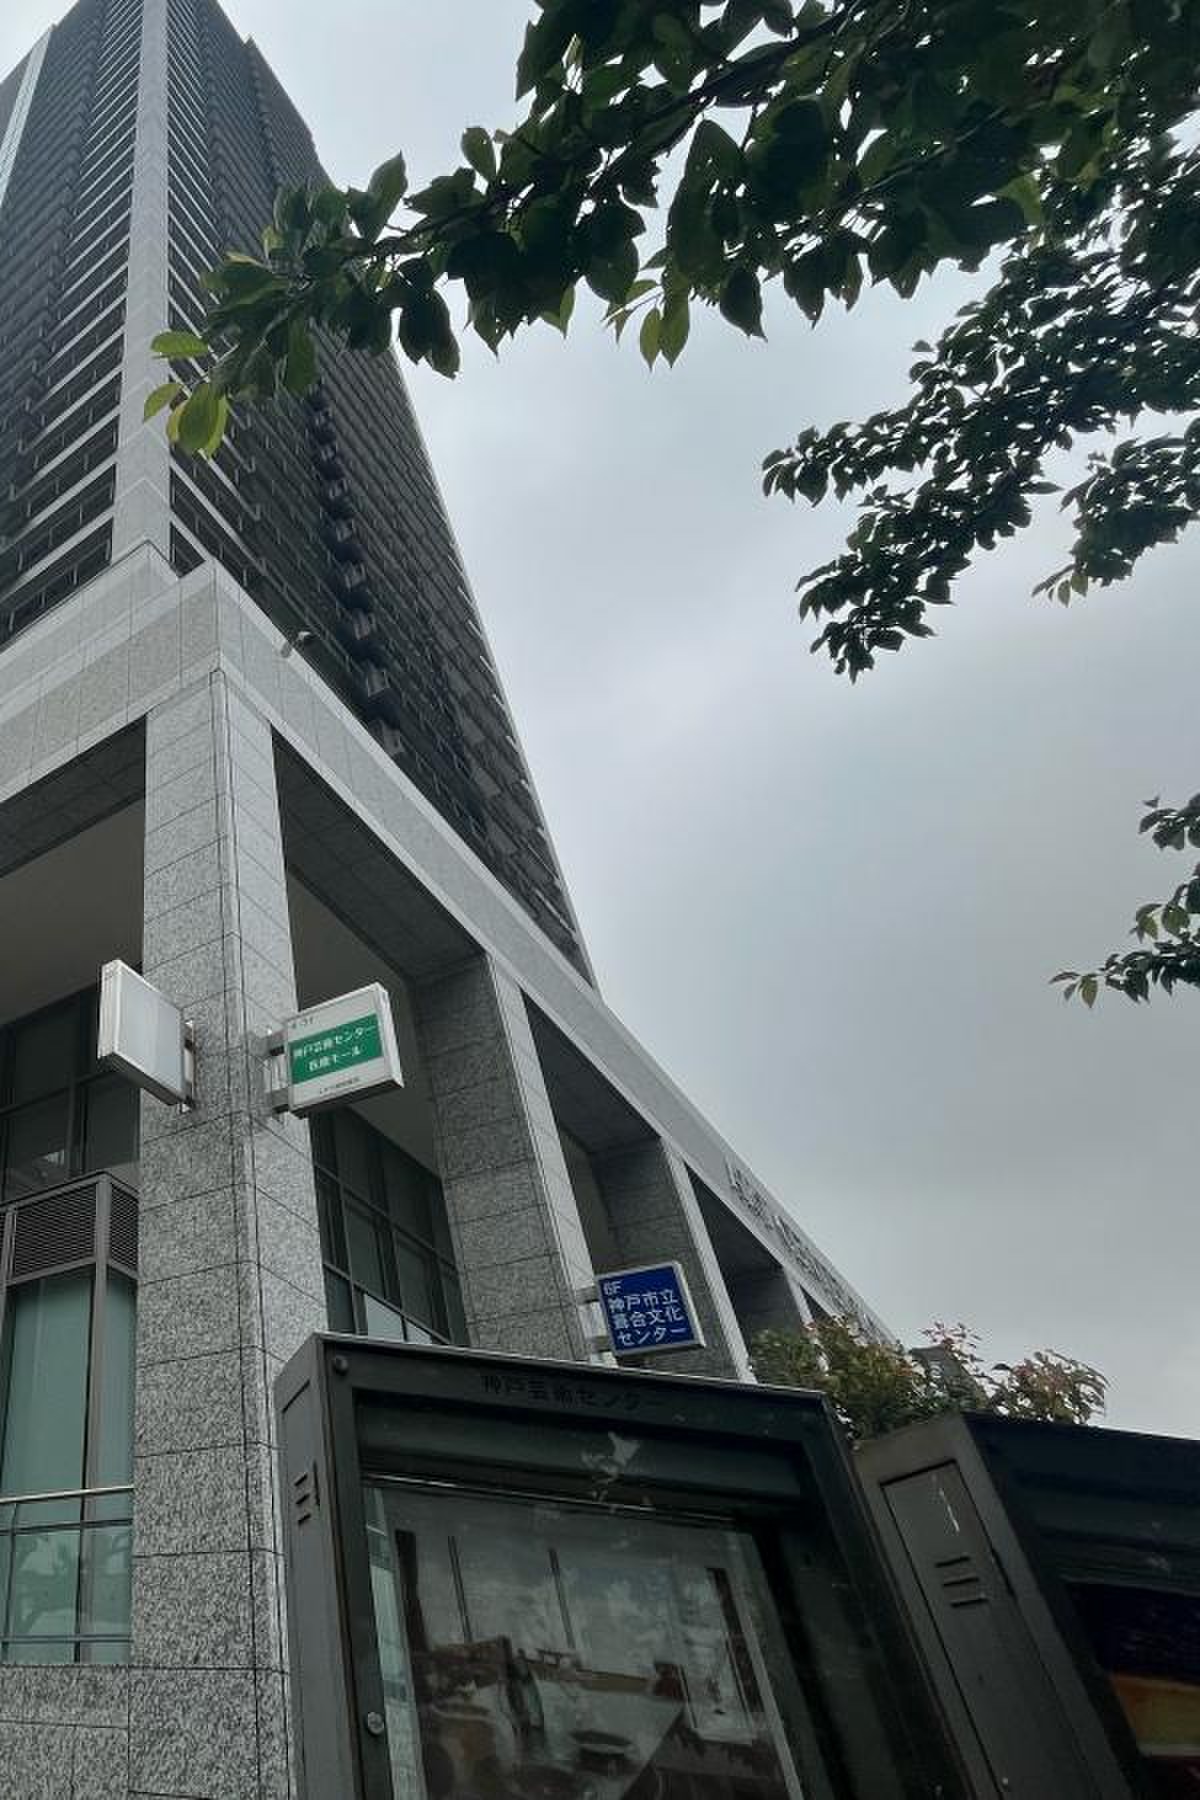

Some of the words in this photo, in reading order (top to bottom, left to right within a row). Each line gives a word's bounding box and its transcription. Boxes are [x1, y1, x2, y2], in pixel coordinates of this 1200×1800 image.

[608, 1288, 678, 1313] 神戸市立
[617, 1327, 687, 1346] センター
